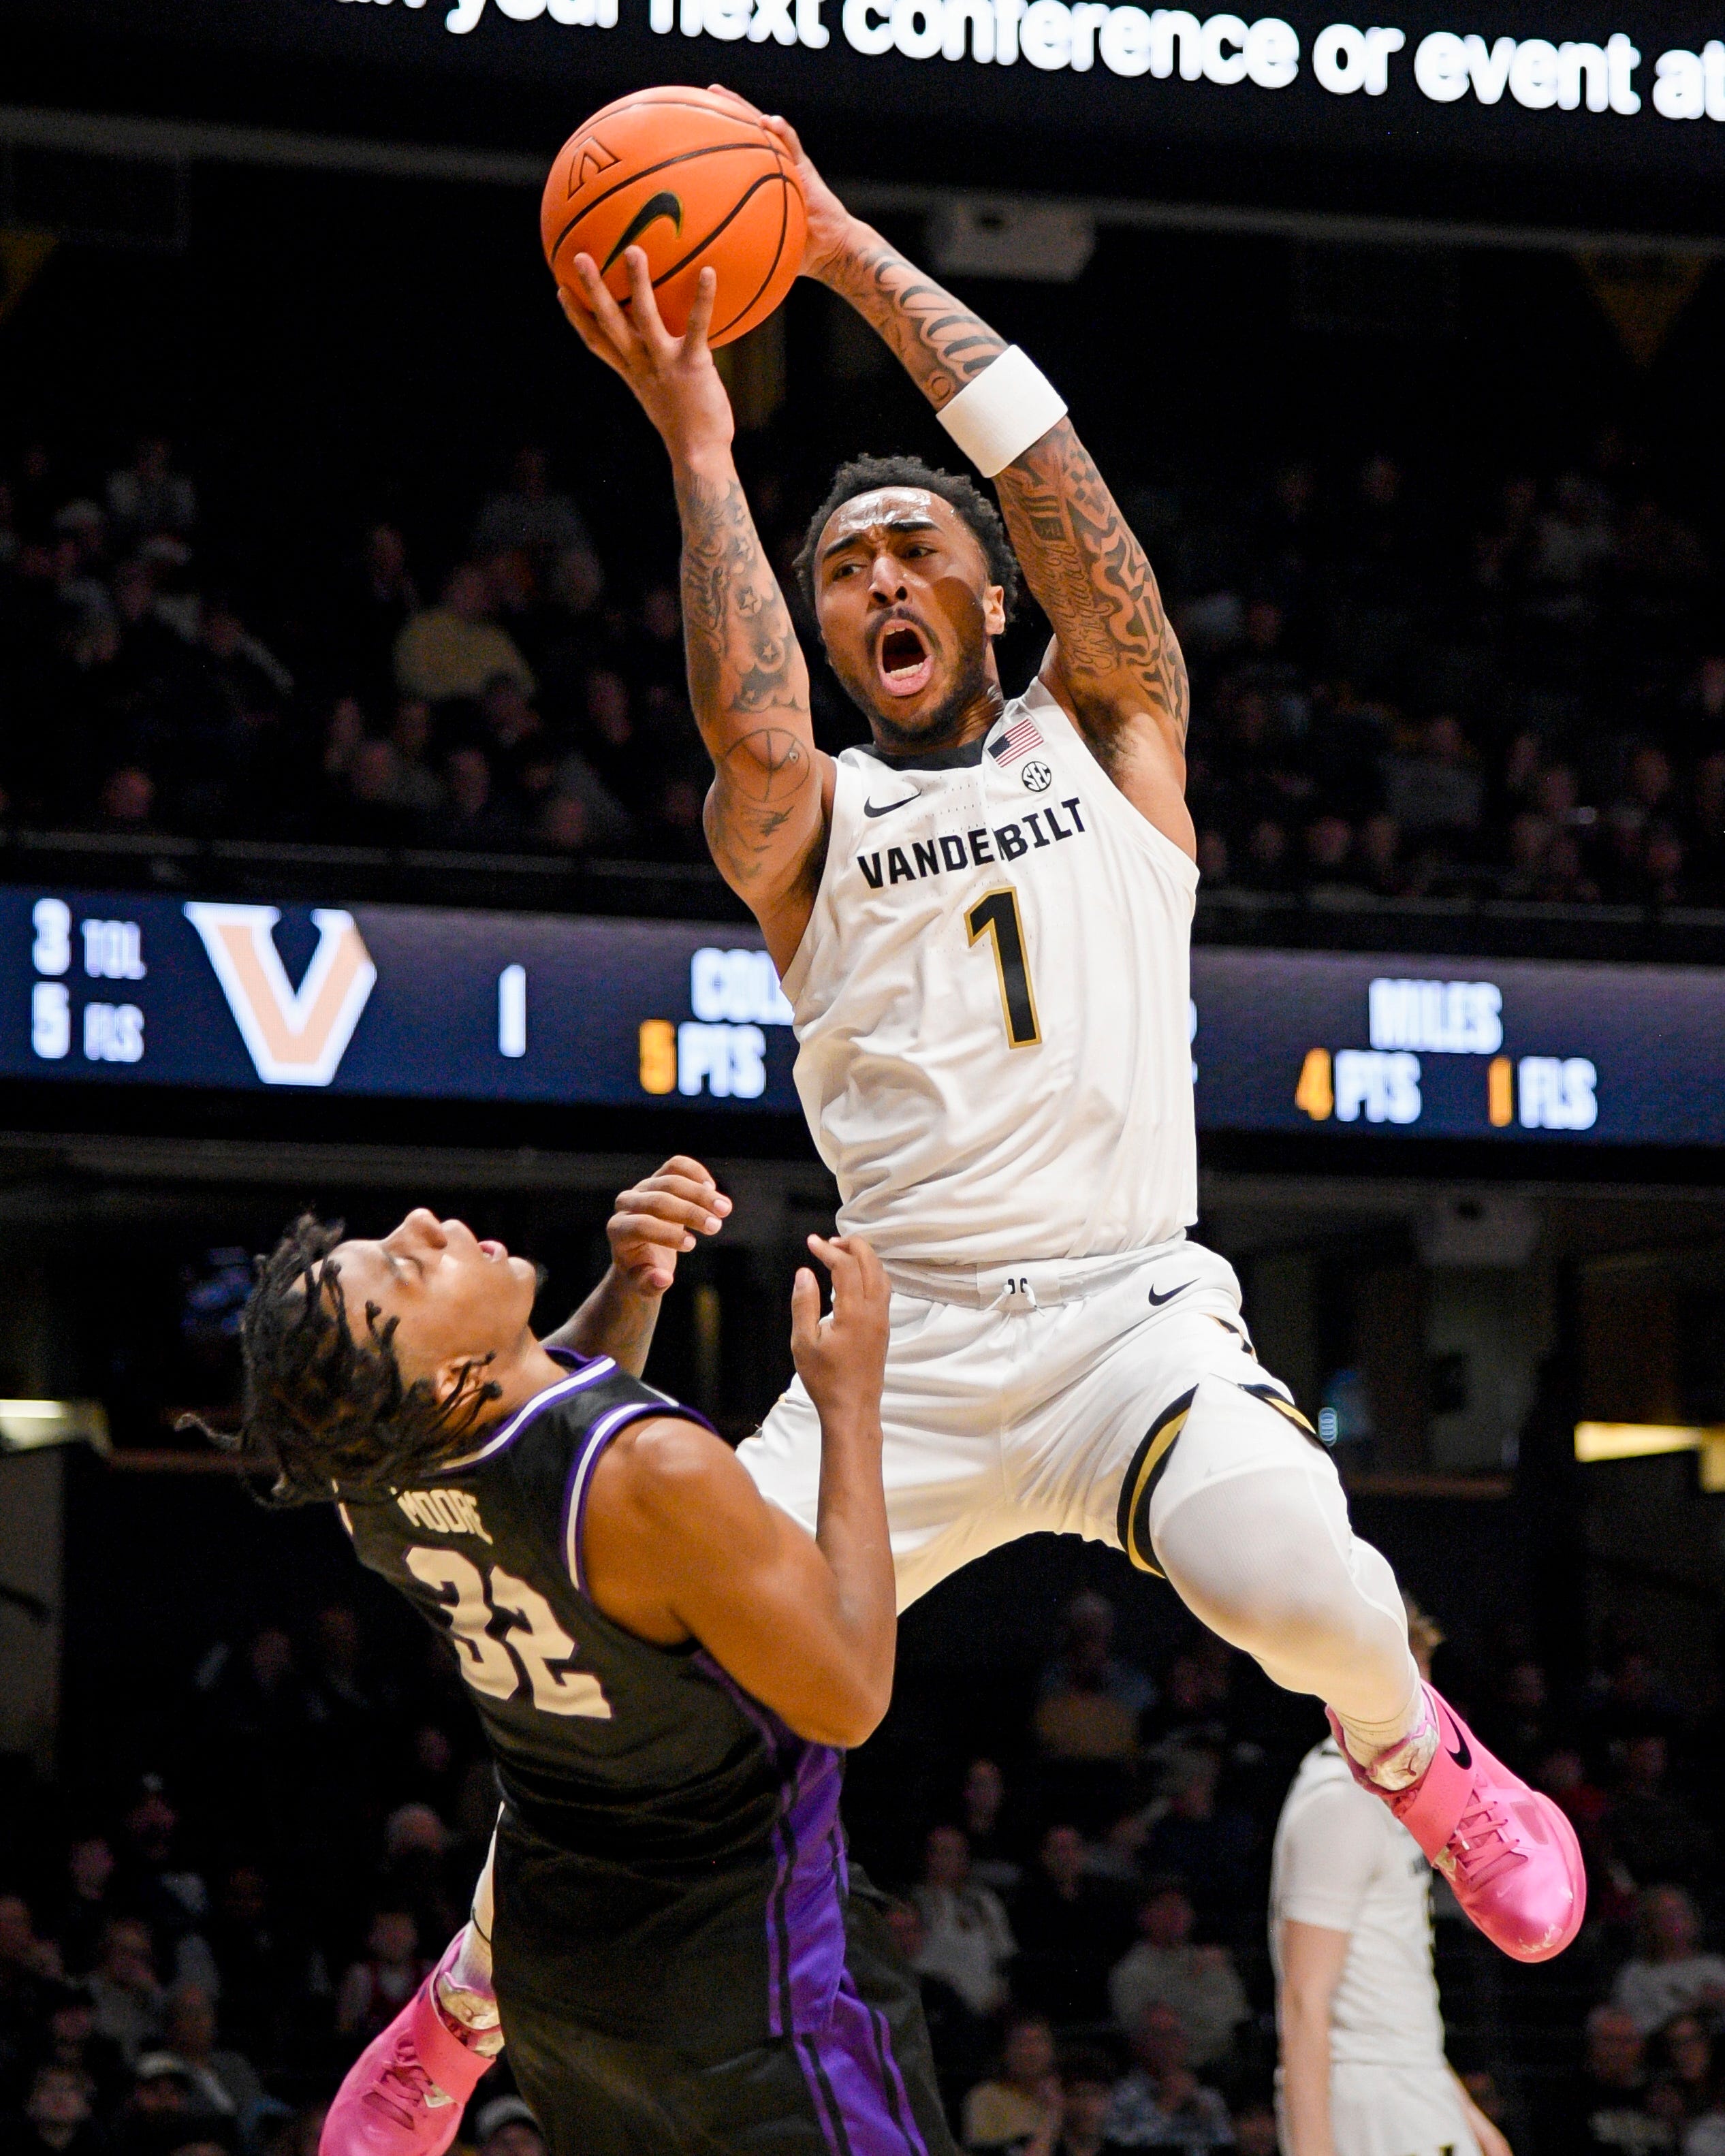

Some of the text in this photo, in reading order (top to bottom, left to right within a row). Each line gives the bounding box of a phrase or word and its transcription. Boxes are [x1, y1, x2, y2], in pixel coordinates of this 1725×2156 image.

[842, 0, 1299, 89] conference
[1312, 23, 1406, 95] or
[1414, 31, 1641, 114] event
[1022, 761, 1051, 791] SEC
[857, 797, 1086, 889] VANDEBILT
[33, 898, 69, 975] 3
[964, 887, 1043, 1049] 1
[1369, 977, 1502, 1053] MILES
[678, 1021, 765, 1098] PTS
[1297, 1047, 1332, 1120] 4
[1335, 1049, 1421, 1123] PTS
[1489, 1058, 1512, 1127] 1
[405, 1546, 612, 1719] 32
